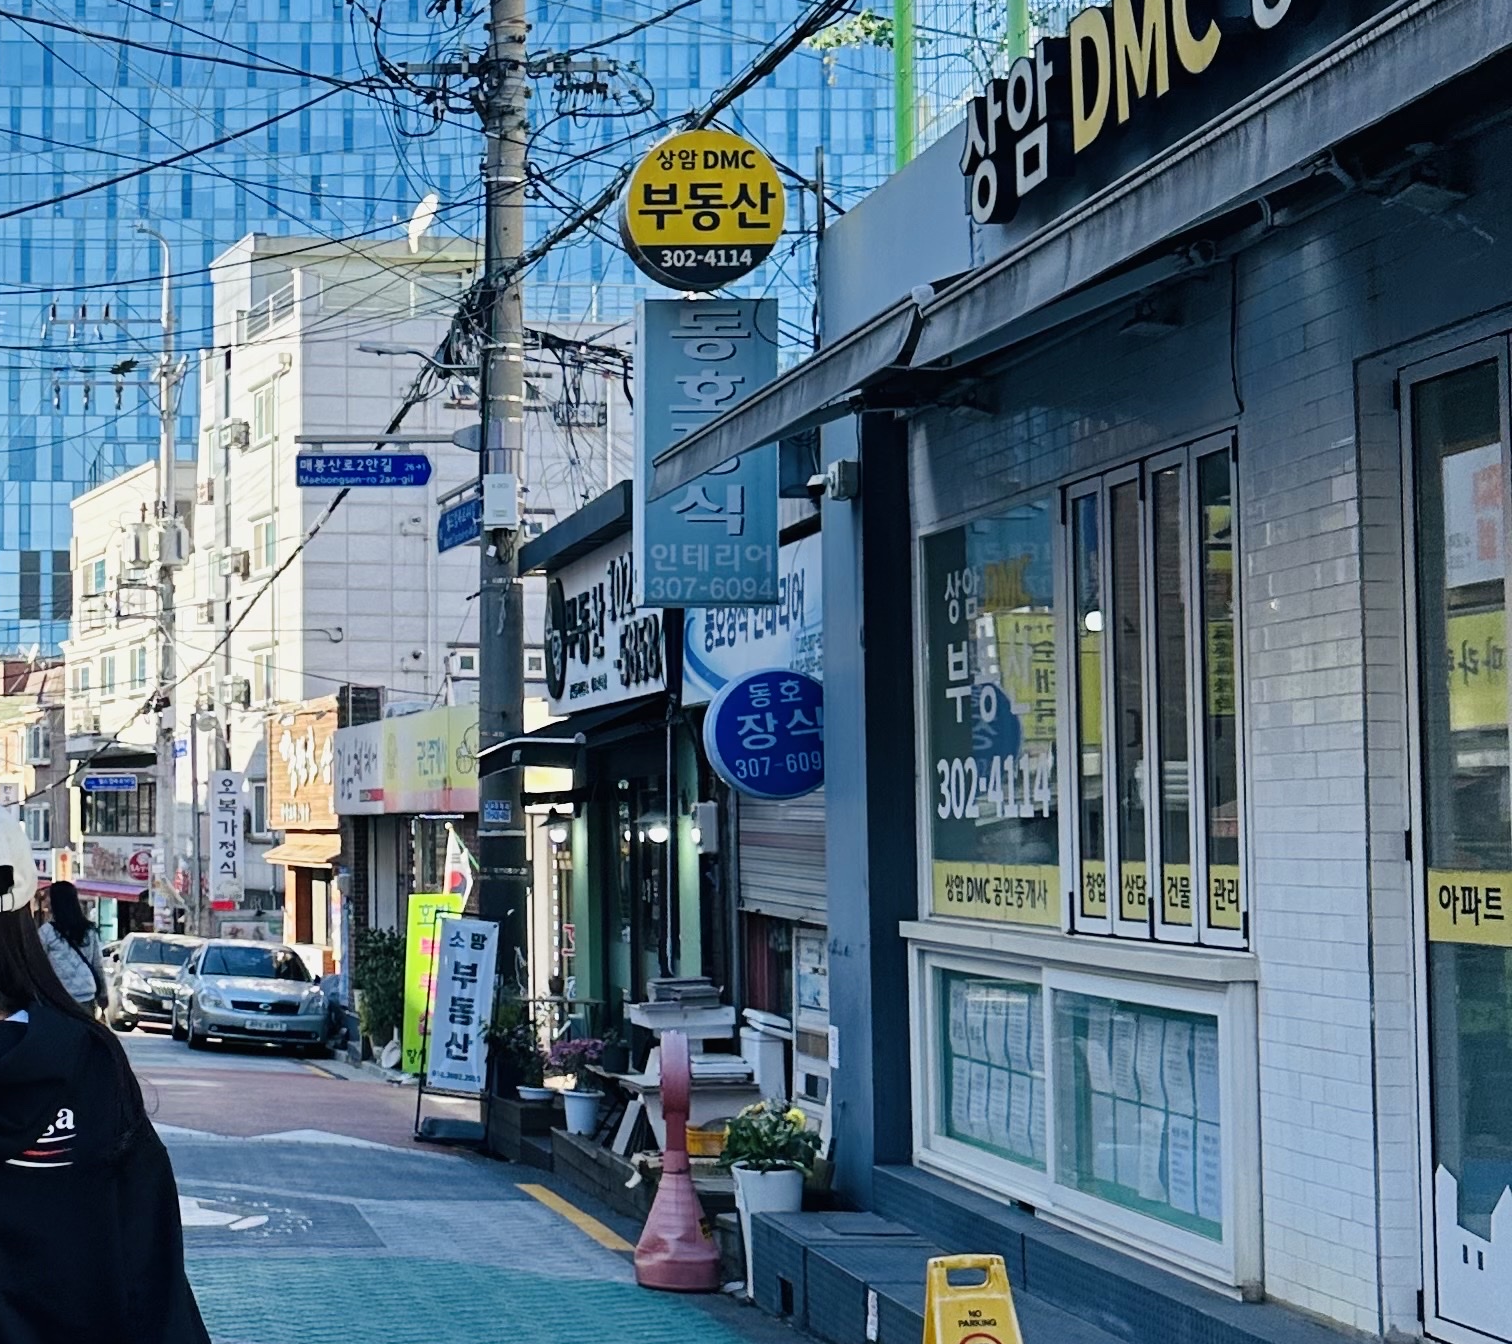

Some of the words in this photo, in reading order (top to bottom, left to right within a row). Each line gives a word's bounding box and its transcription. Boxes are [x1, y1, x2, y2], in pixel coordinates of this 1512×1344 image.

[960, 55, 1053, 225] 상암
[656, 149, 699, 171] 상암
[703, 150, 757, 170] DMC
[638, 182, 776, 232] 부동산
[660, 249, 753, 268] 302-4114
[299, 458, 393, 473] 매봉산로2안길
[299, 475, 377, 485] Maebongsan-ro
[379, 474, 414, 485] 2an-gil
[650, 544, 773, 573] 인테리어
[650, 578, 775, 601] 307-6094
[945, 567, 980, 625] 상암
[748, 679, 803, 709] 동호
[737, 706, 824, 751] 장식
[735, 750, 823, 780] 307-609
[937, 754, 1051, 819] 302-4114
[217, 778, 238, 880] 오복가정식
[945, 872, 965, 904] 상암
[966, 877, 991, 905] DMC
[992, 876, 1048, 913] 공인중개사
[1124, 872, 1146, 906] 상담
[1167, 875, 1191, 910] 건물
[1439, 885, 1505, 926] 아파트
[449, 931, 488, 951] 소망
[444, 960, 478, 1062] 부동산
[958, 1319, 997, 1328] PARKING
[968, 1309, 982, 1318] NO
